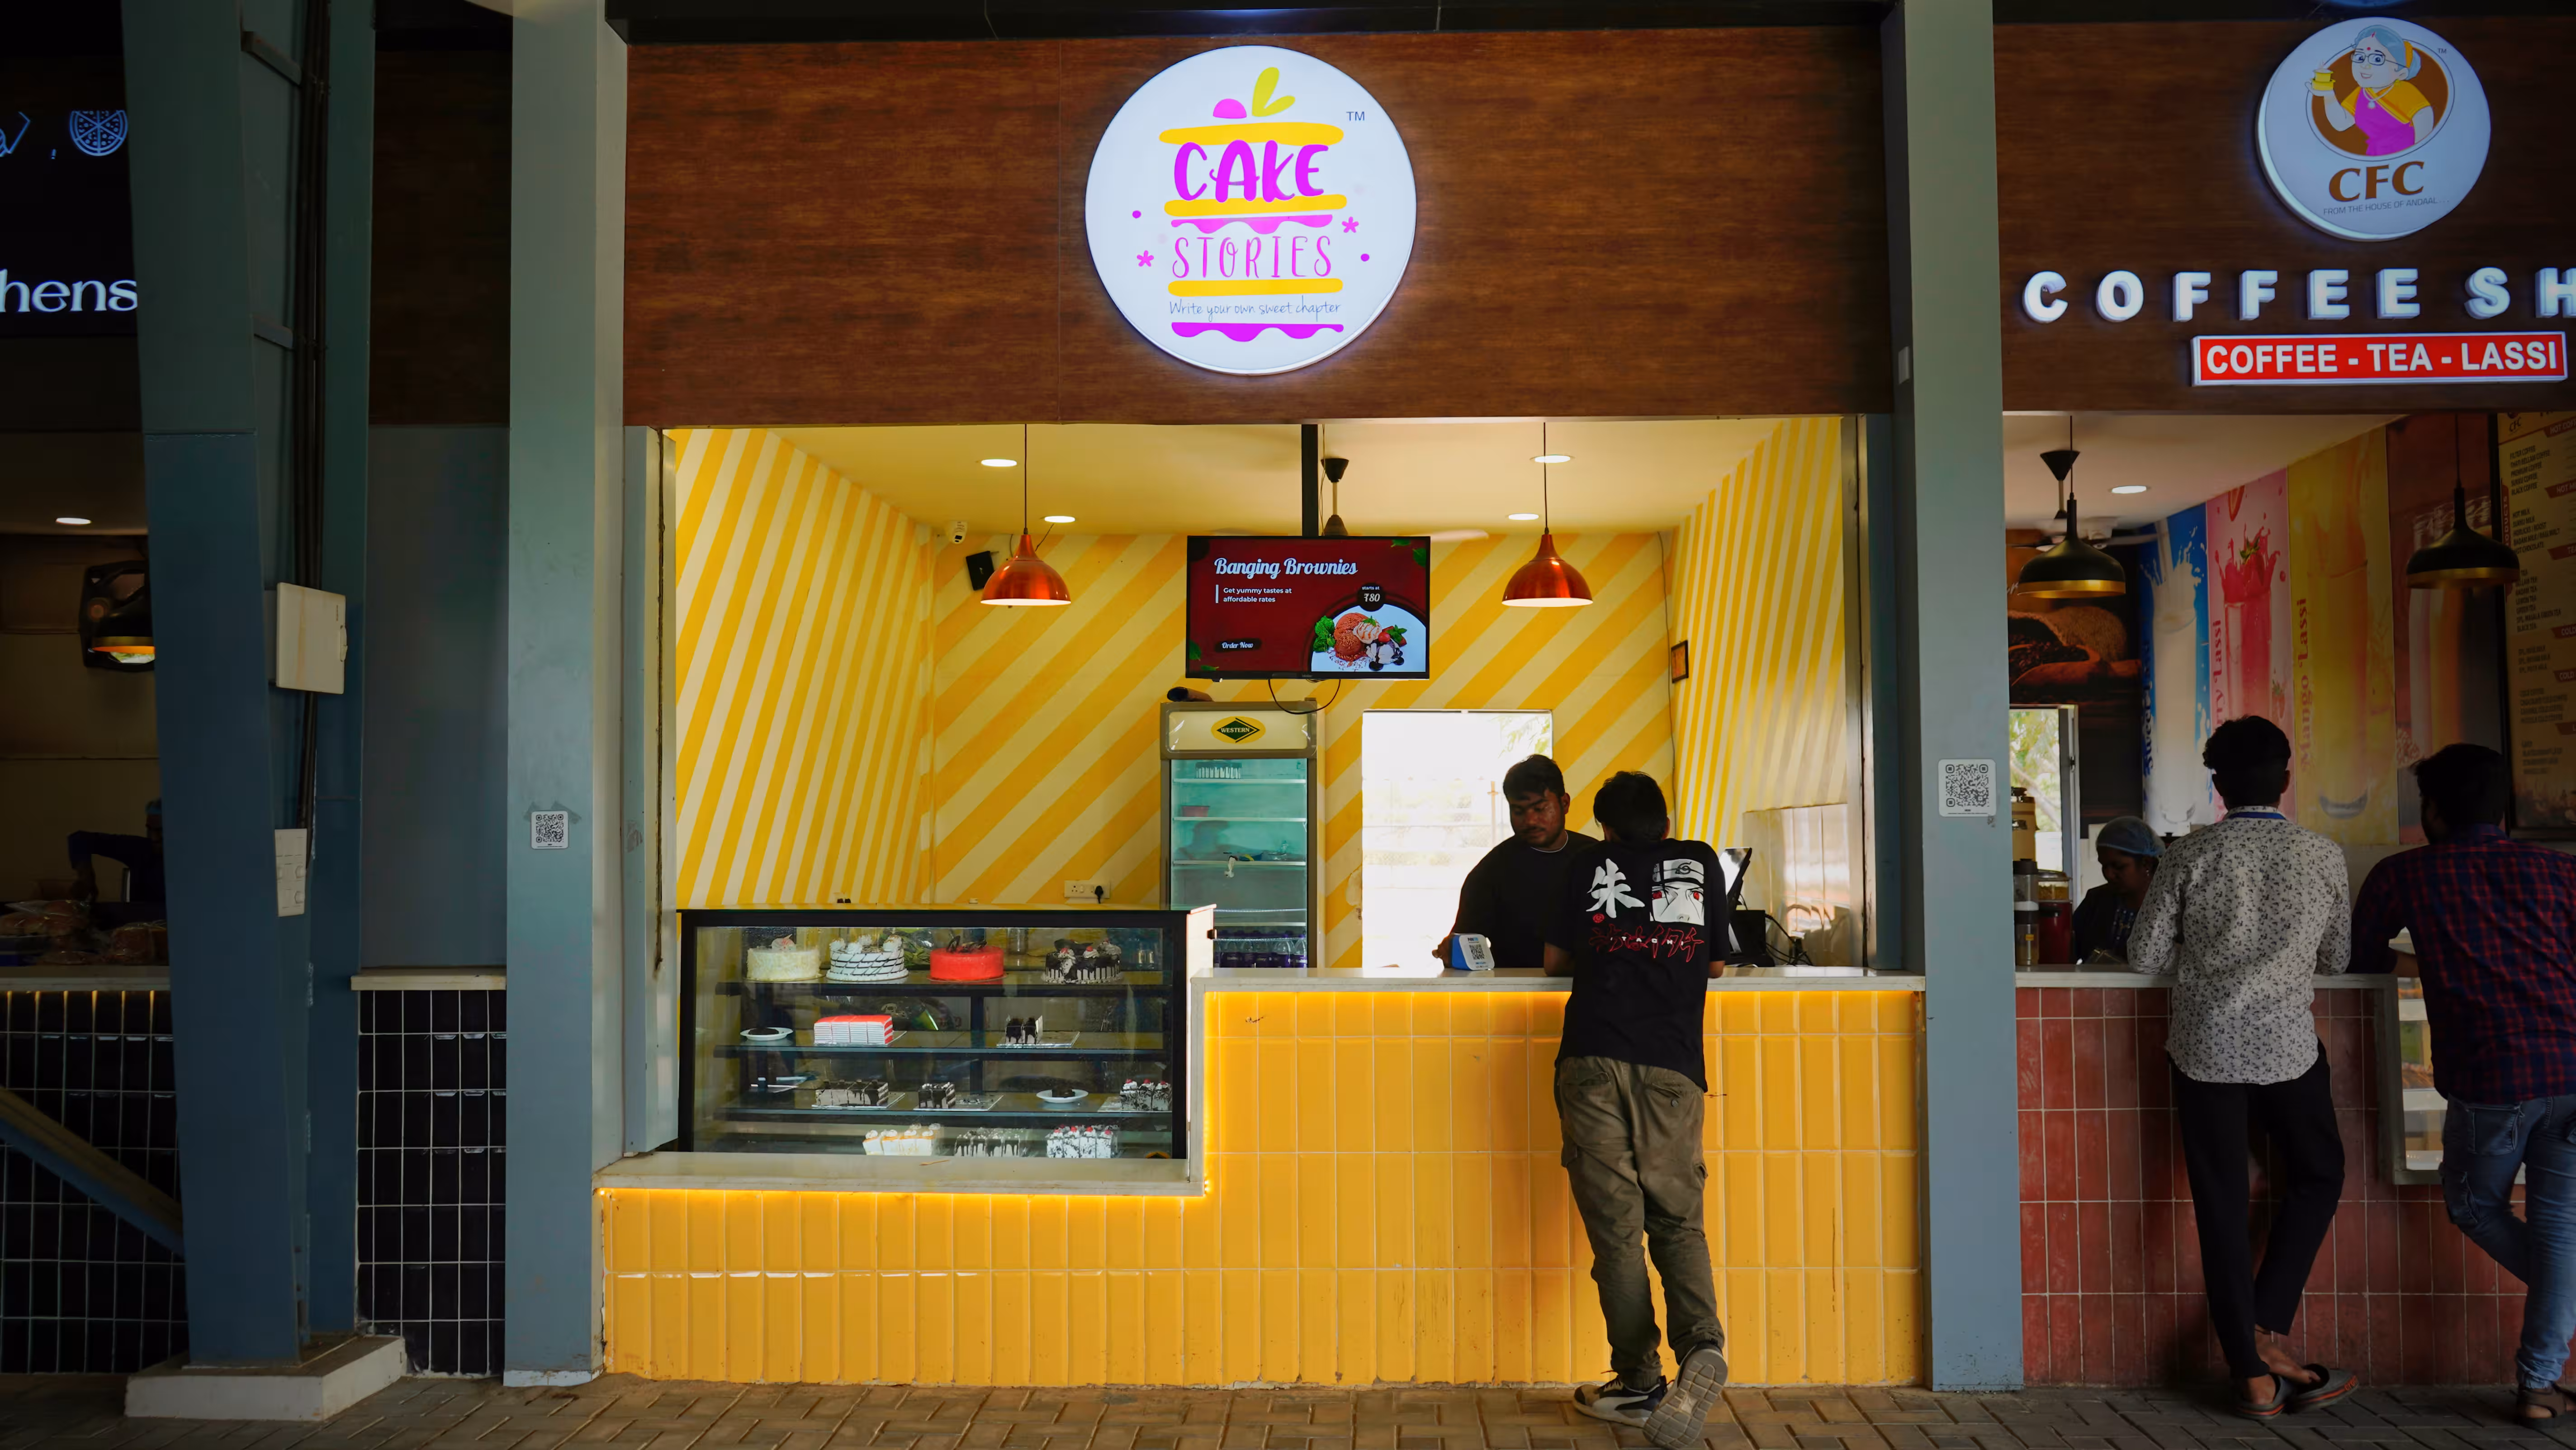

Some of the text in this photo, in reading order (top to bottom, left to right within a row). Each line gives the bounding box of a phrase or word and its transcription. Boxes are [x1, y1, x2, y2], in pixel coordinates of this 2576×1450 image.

[1346, 112, 1365, 121] TM
[1174, 140, 1329, 203] CAKE
[2329, 161, 2424, 202] CFC
[2324, 207, 2346, 215] FROM
[2348, 204, 2363, 213] THE
[2365, 202, 2391, 212] HOUSE
[1172, 236, 1331, 278] STORIES
[2022, 269, 2420, 323] COFFEE
[1170, 295, 1342, 322] Write your own sweet chapter
[2207, 344, 2338, 374] COFFEE
[2367, 343, 2433, 372] TEA
[2462, 341, 2557, 370] LASSI
[2550, 424, 2561, 434] HOT
[2522, 445, 2535, 455] COFFEE
[2536, 450, 2550, 459] COFFEE
[2528, 461, 2542, 472] COFFEE
[2524, 473, 2537, 482] COFFEE
[2512, 482, 2537, 496] BLACK COFFEE
[2557, 485, 2567, 494] HOT
[1214, 558, 1358, 579] Banging Brownies
[2212, 620, 2223, 683] Lassi
[2560, 671, 2574, 680] COLD
